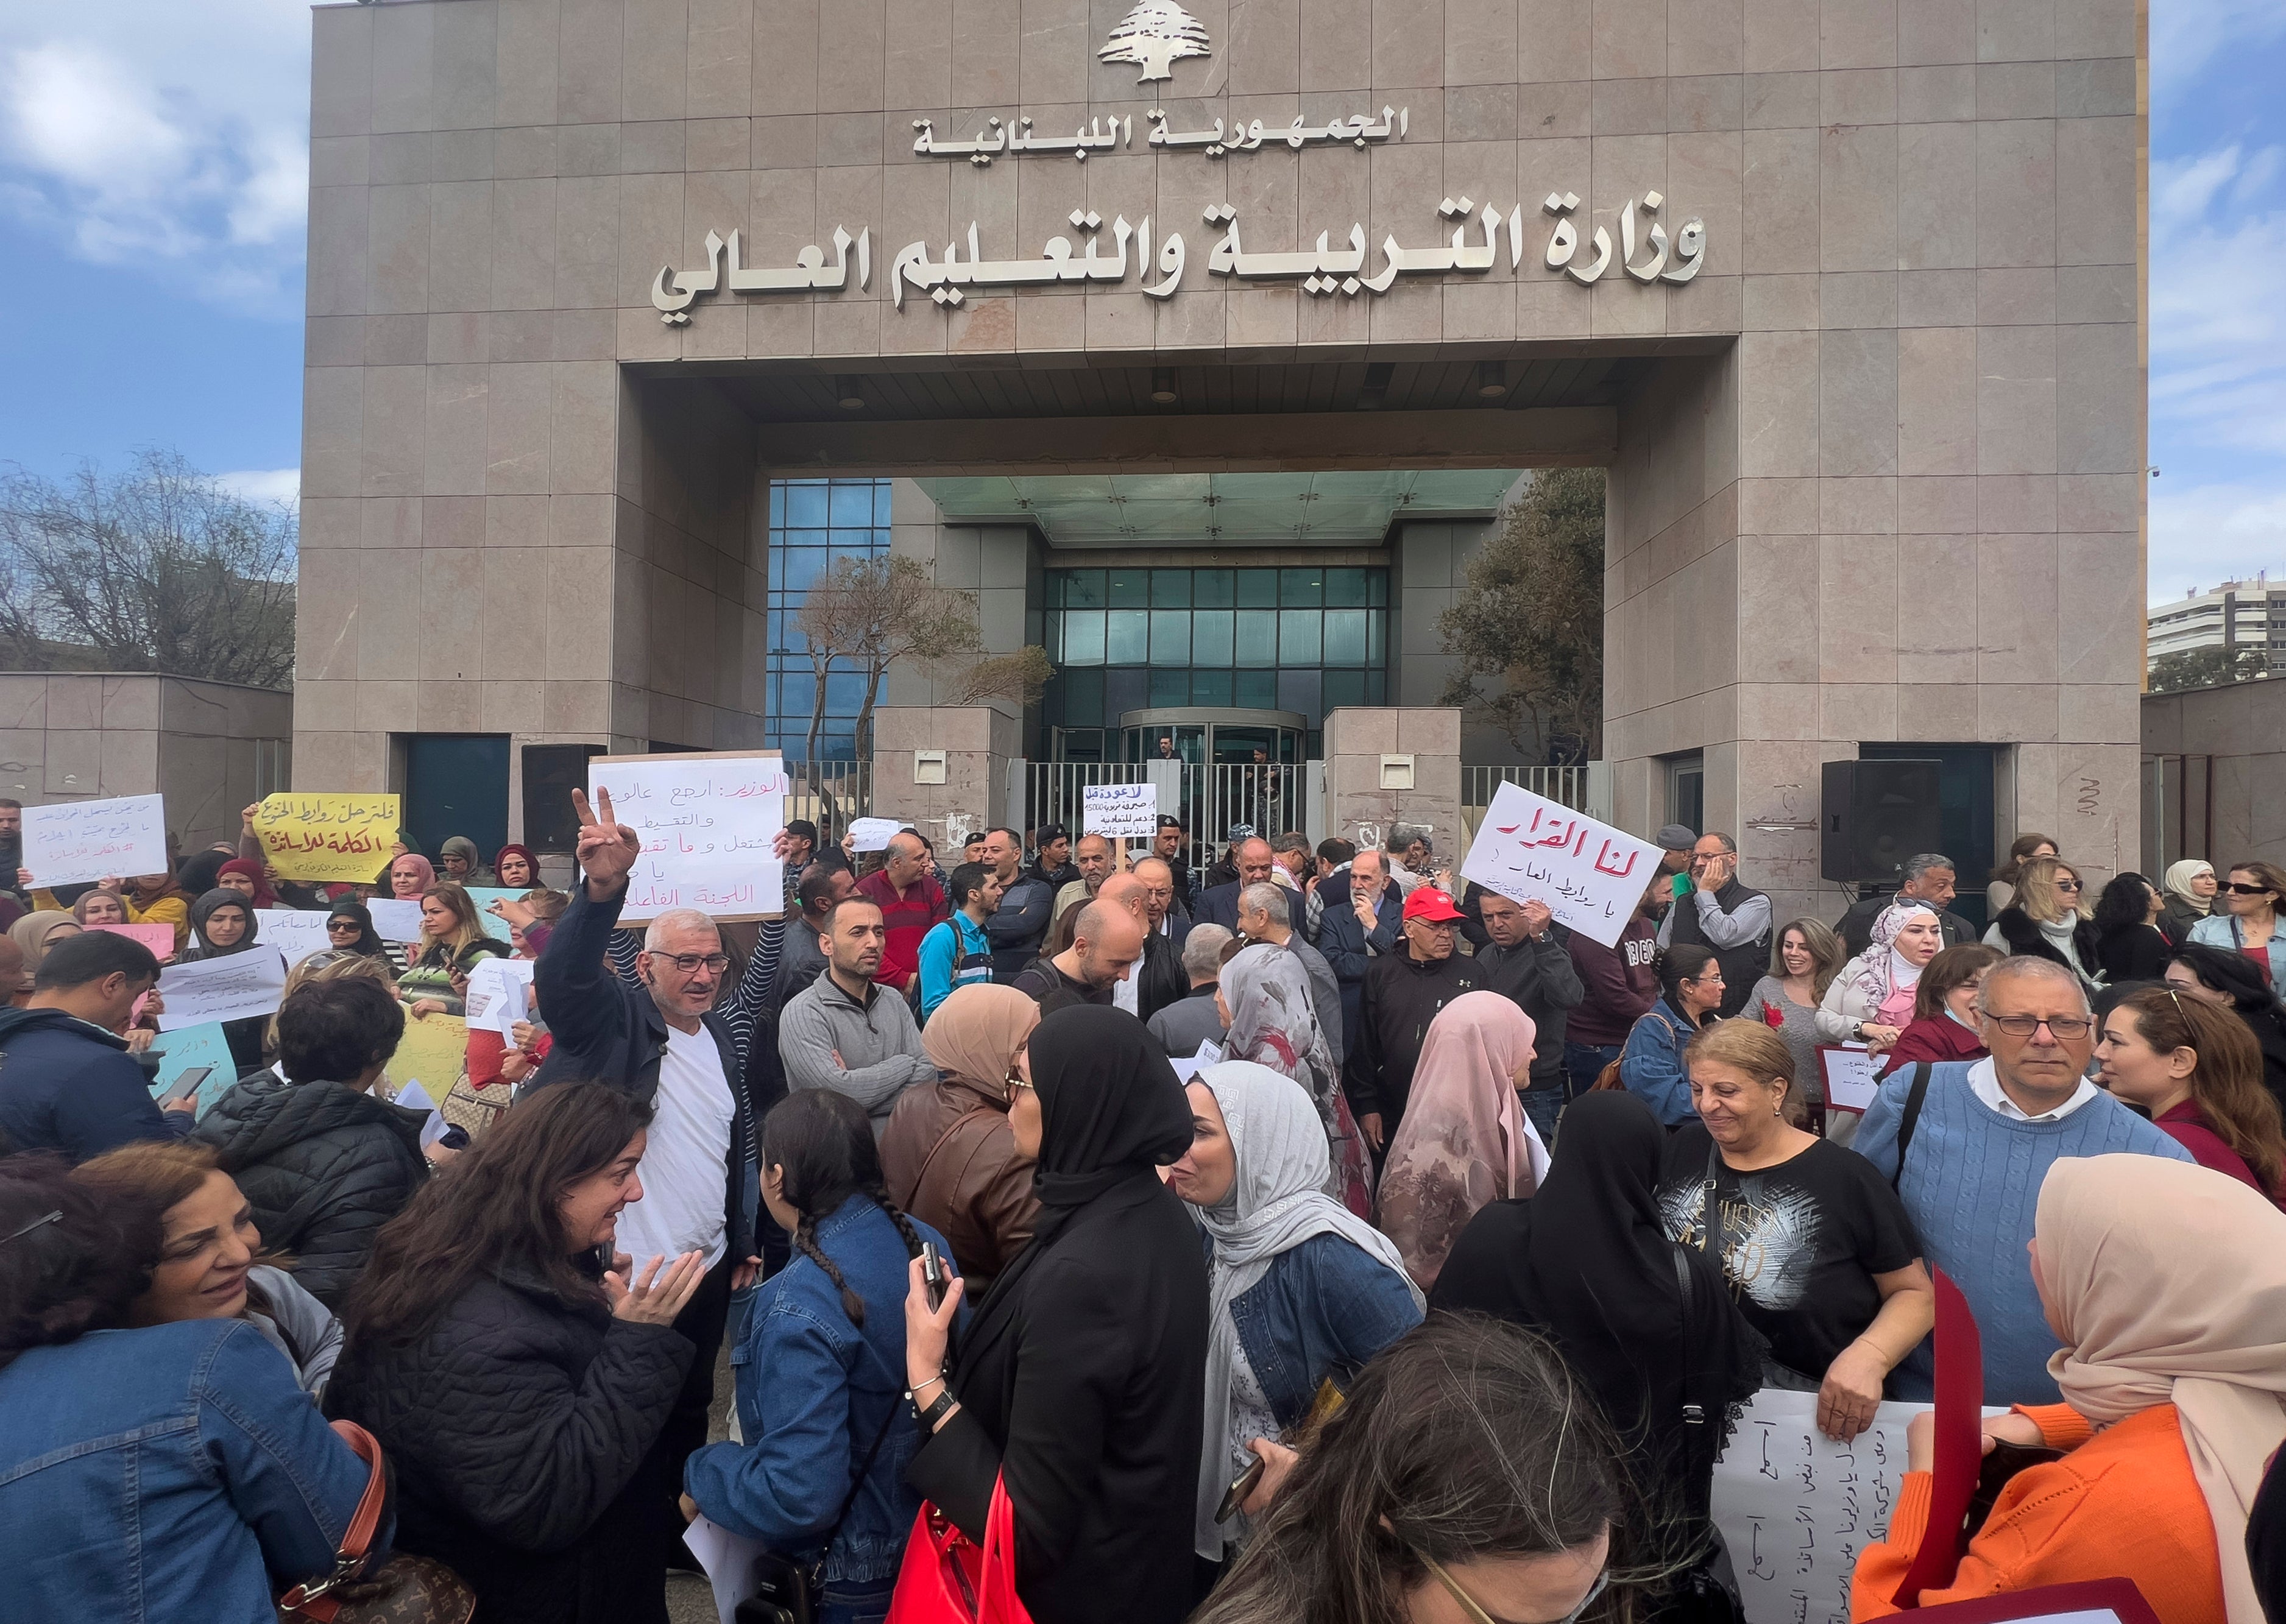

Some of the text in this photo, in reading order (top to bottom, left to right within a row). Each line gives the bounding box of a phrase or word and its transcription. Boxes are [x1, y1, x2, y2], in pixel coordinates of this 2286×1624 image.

[913, 104, 1410, 166] الجمهورية اللبنانية
[651, 189, 1707, 327] وزارة التربية والتعليم العالي
[670, 780, 712, 806] ارجع
[1086, 785, 1141, 800] لا عودة قبل
[327, 827, 383, 854] الكلمة
[678, 832, 694, 853] ما
[1496, 807, 1640, 878] لنا القرار
[651, 861, 664, 881] يا
[1509, 861, 1552, 884] العار
[693, 884, 754, 907] اللجنة
[1555, 878, 1596, 907] روابط
[1605, 900, 1615, 919] يا
[1754, 1421, 1778, 1480] اسمع
[1801, 1435, 1812, 1456] من
[1795, 1463, 1818, 1494] نبض
[1872, 1470, 1890, 1518] شركة
[1747, 1515, 1775, 1581] اسمع
